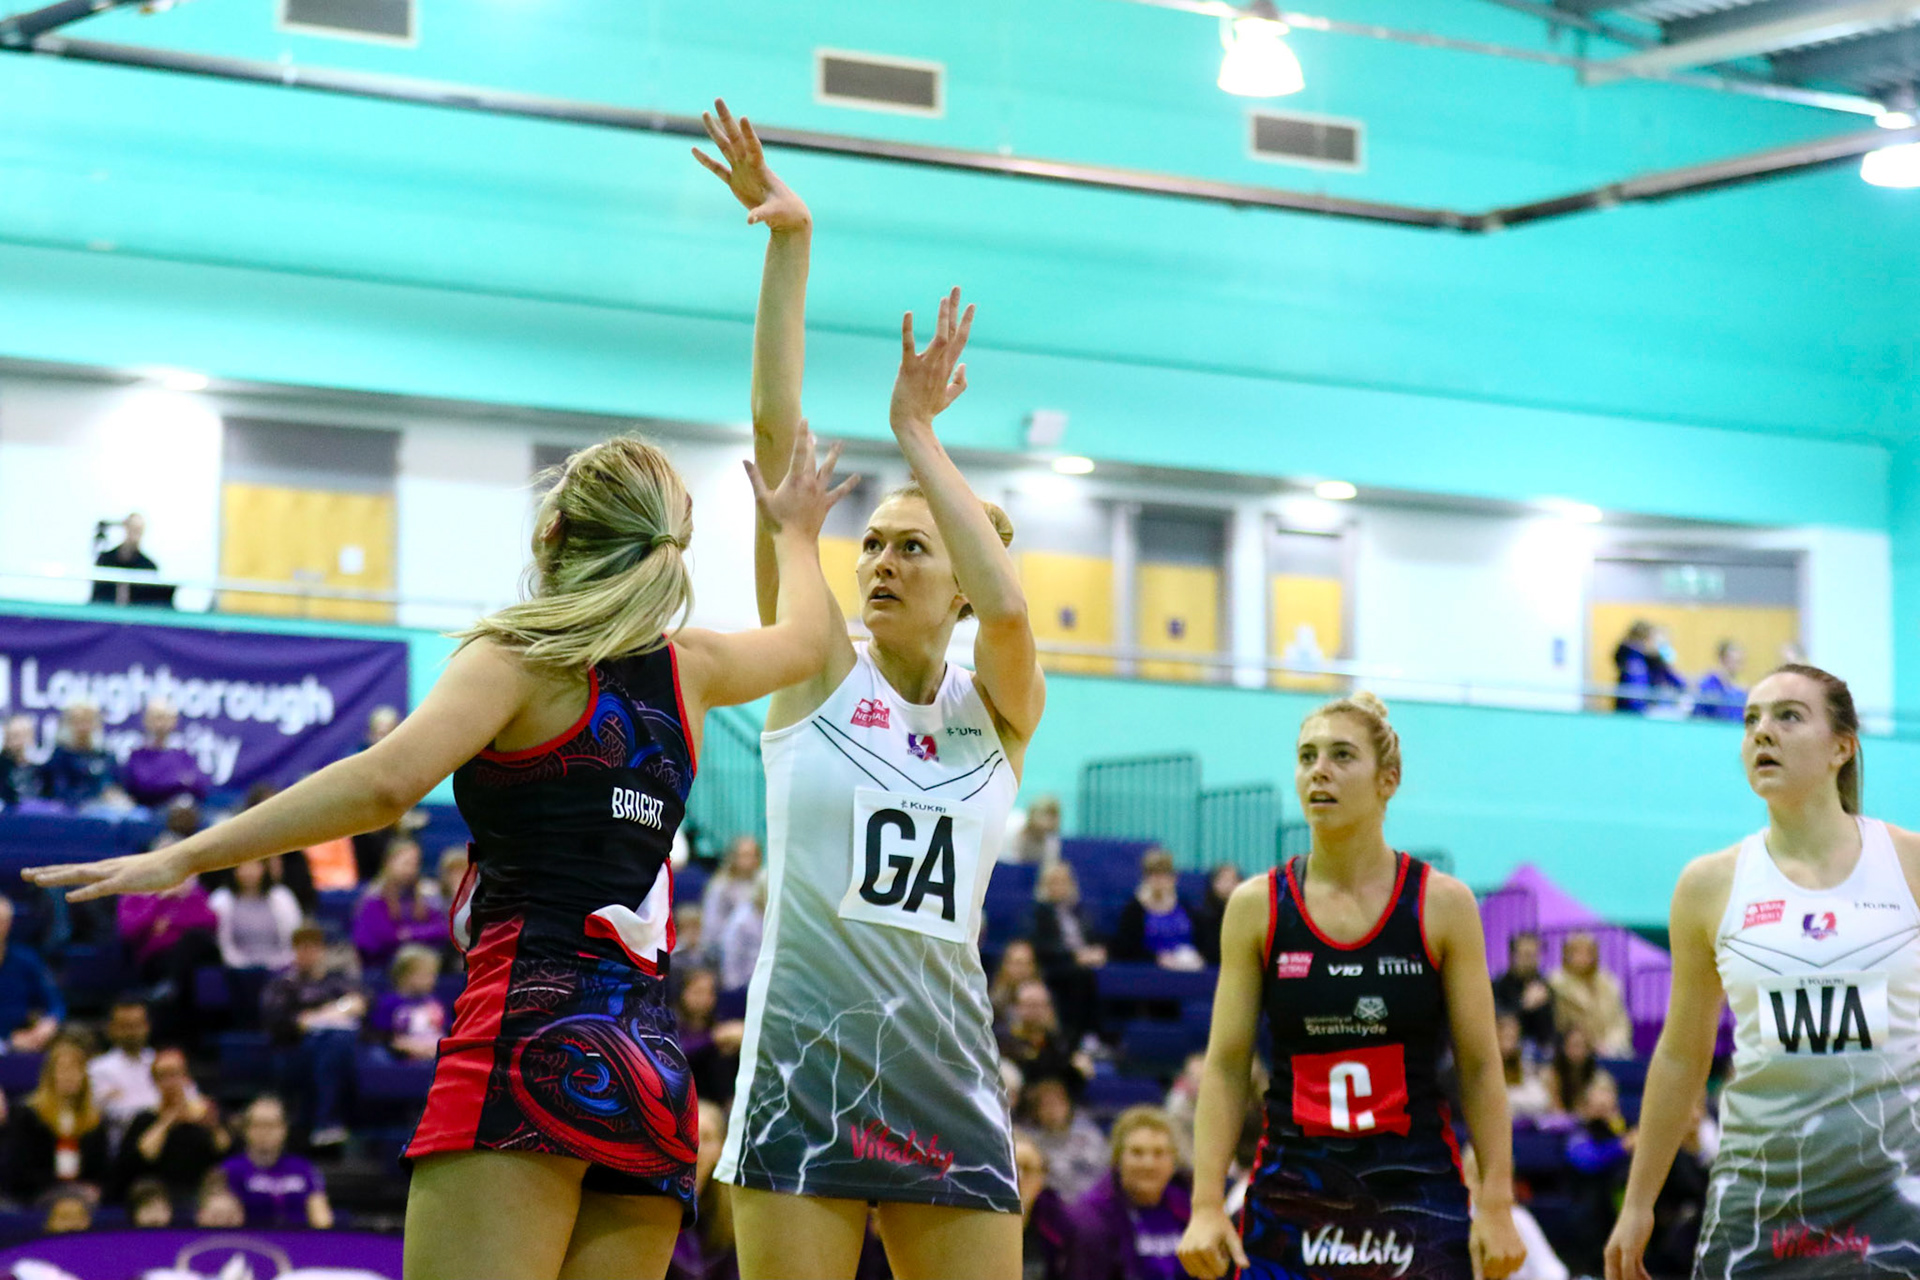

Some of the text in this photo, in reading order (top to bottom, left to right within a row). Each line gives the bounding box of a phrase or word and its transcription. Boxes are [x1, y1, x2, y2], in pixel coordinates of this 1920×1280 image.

[20, 656, 335, 736] Loughborough
[611, 786, 664, 831] BRIGHT
[909, 801, 947, 814] KUKRI
[859, 808, 956, 923] GA
[1305, 1022, 1388, 1037] Strathclyde
[1769, 985, 1873, 1054] WA
[1328, 1061, 1377, 1132] C
[850, 1119, 955, 1180] Vitality
[1301, 1222, 1415, 1279] Vitality
